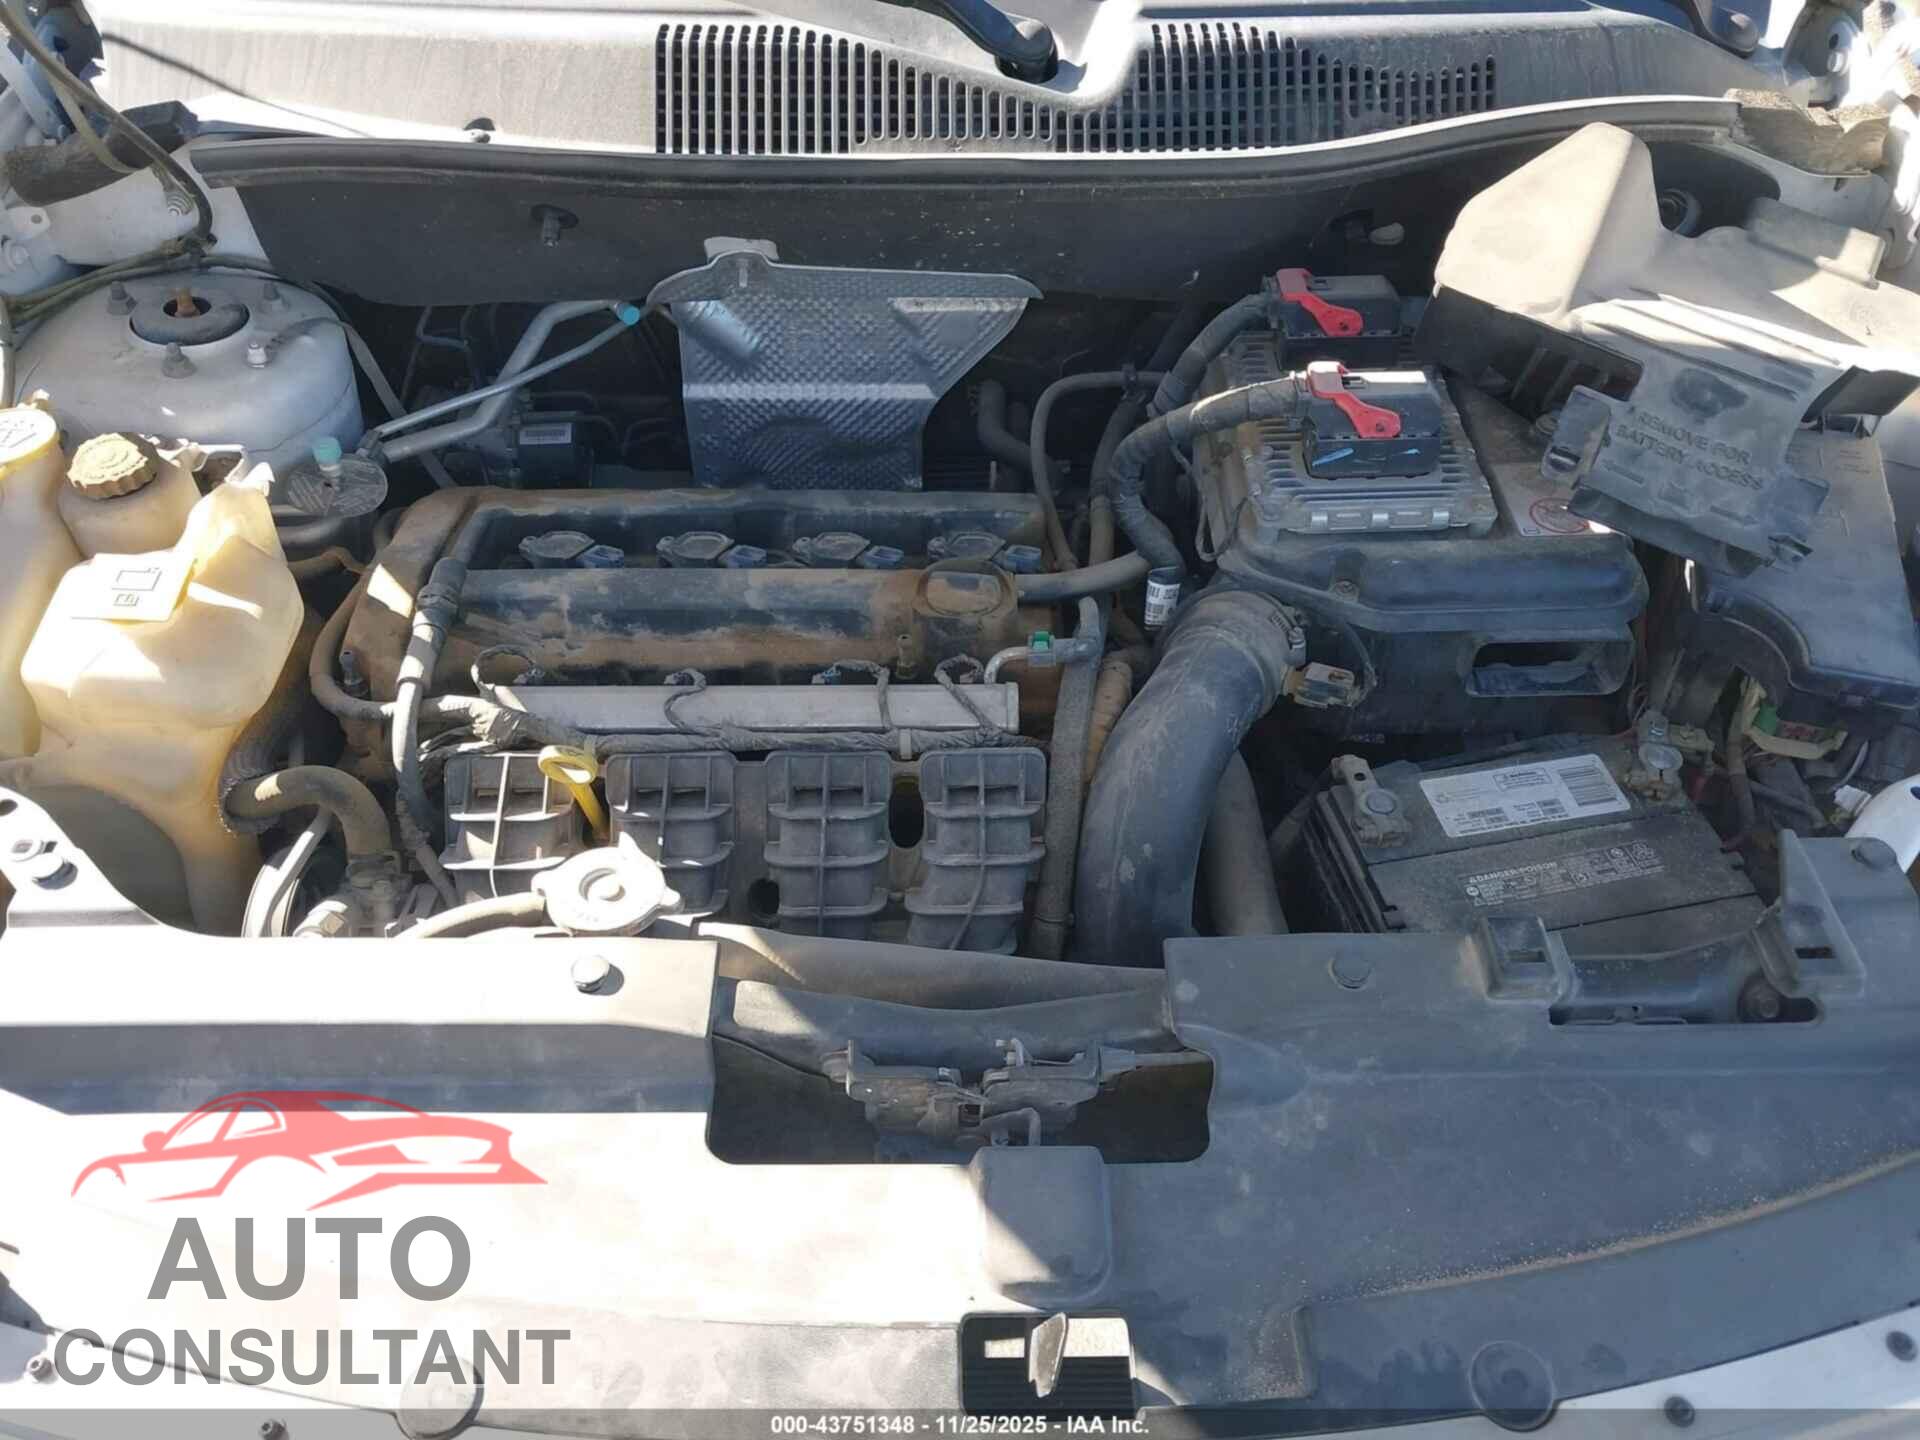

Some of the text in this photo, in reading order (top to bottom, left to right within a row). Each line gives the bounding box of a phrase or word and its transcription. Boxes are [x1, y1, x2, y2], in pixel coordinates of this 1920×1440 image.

[1615, 423, 1689, 466] BATTERY
[1637, 411, 1751, 466] REMOVE FOR
